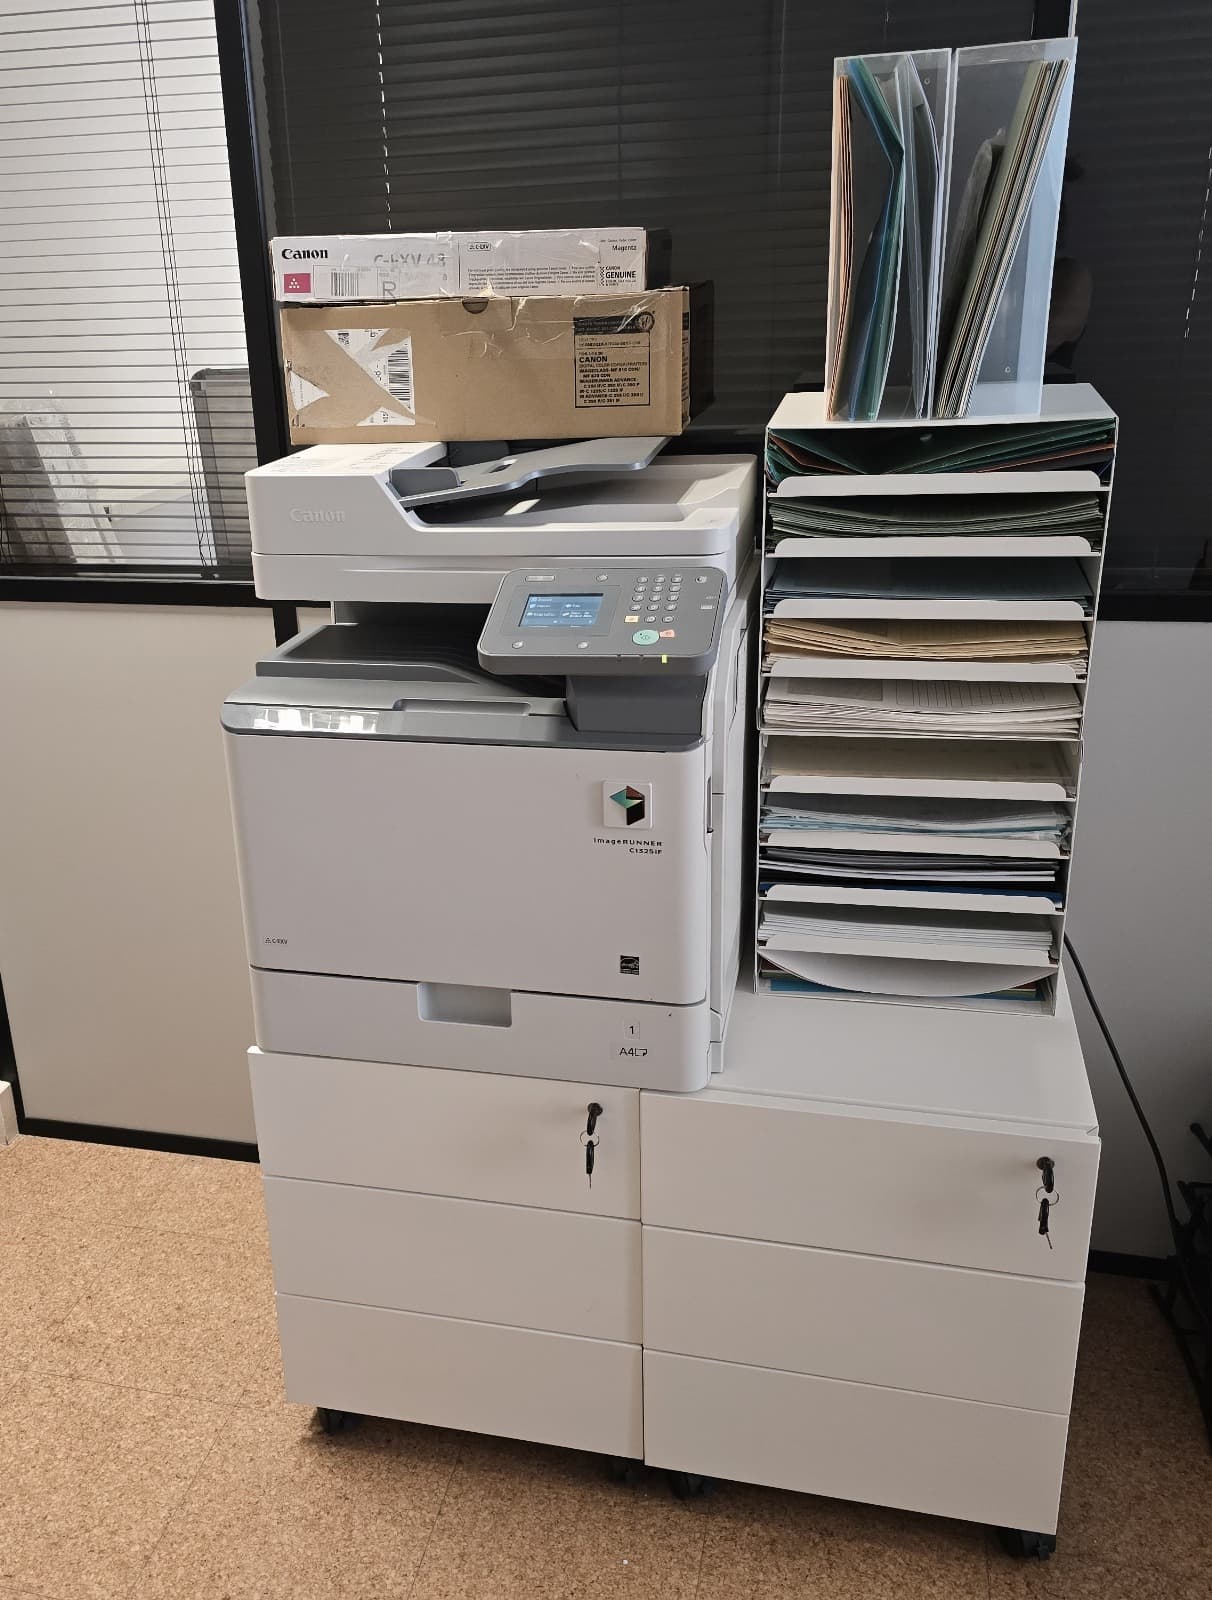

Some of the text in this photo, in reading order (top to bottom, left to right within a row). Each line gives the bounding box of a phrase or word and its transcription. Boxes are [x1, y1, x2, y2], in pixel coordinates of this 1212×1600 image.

[612, 244, 637, 252] Magenta
[281, 248, 328, 260] Canon
[605, 270, 637, 279] GENUINE
[579, 355, 608, 363] CANON
[290, 508, 346, 522] Canon
[629, 1025, 634, 1035] 1
[619, 1047, 634, 1057] A4
